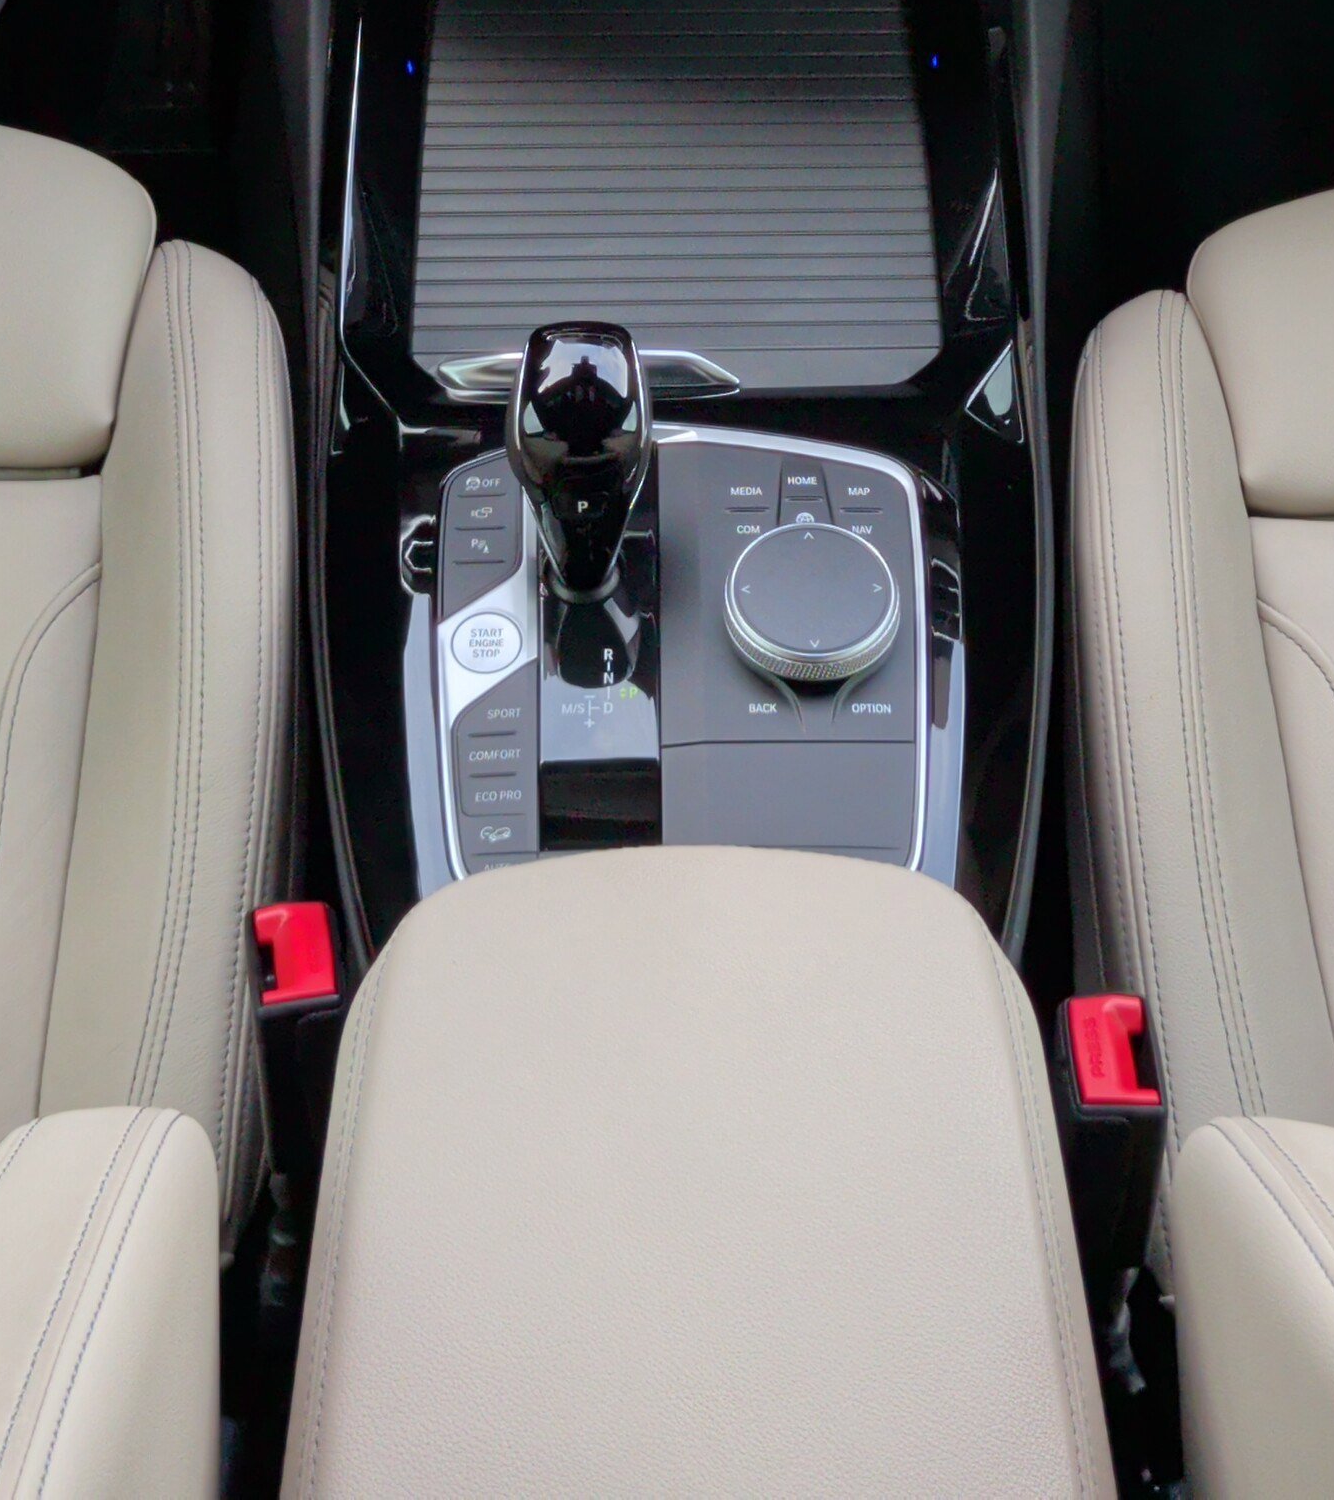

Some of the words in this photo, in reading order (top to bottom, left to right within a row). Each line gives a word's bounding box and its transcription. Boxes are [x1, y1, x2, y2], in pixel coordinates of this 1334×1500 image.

[482, 478, 501, 488] OFF
[787, 476, 818, 486] HOME
[730, 486, 763, 496] MEDIA
[848, 487, 870, 496] MAP
[577, 501, 589, 514] P
[736, 524, 761, 535] COM
[851, 525, 873, 535] NAV
[470, 627, 504, 638] START
[469, 638, 504, 648] ENGINE
[472, 649, 501, 659] STOP
[603, 648, 614, 661] R
[603, 672, 614, 684] N
[487, 707, 521, 719] SPORT
[561, 703, 586, 716] M/S
[603, 702, 614, 714] D
[748, 703, 778, 713] BACK
[851, 703, 892, 714] OPTION
[469, 749, 521, 762] COMFORT
[475, 791, 497, 802] ECO
[499, 789, 522, 801] PRO
